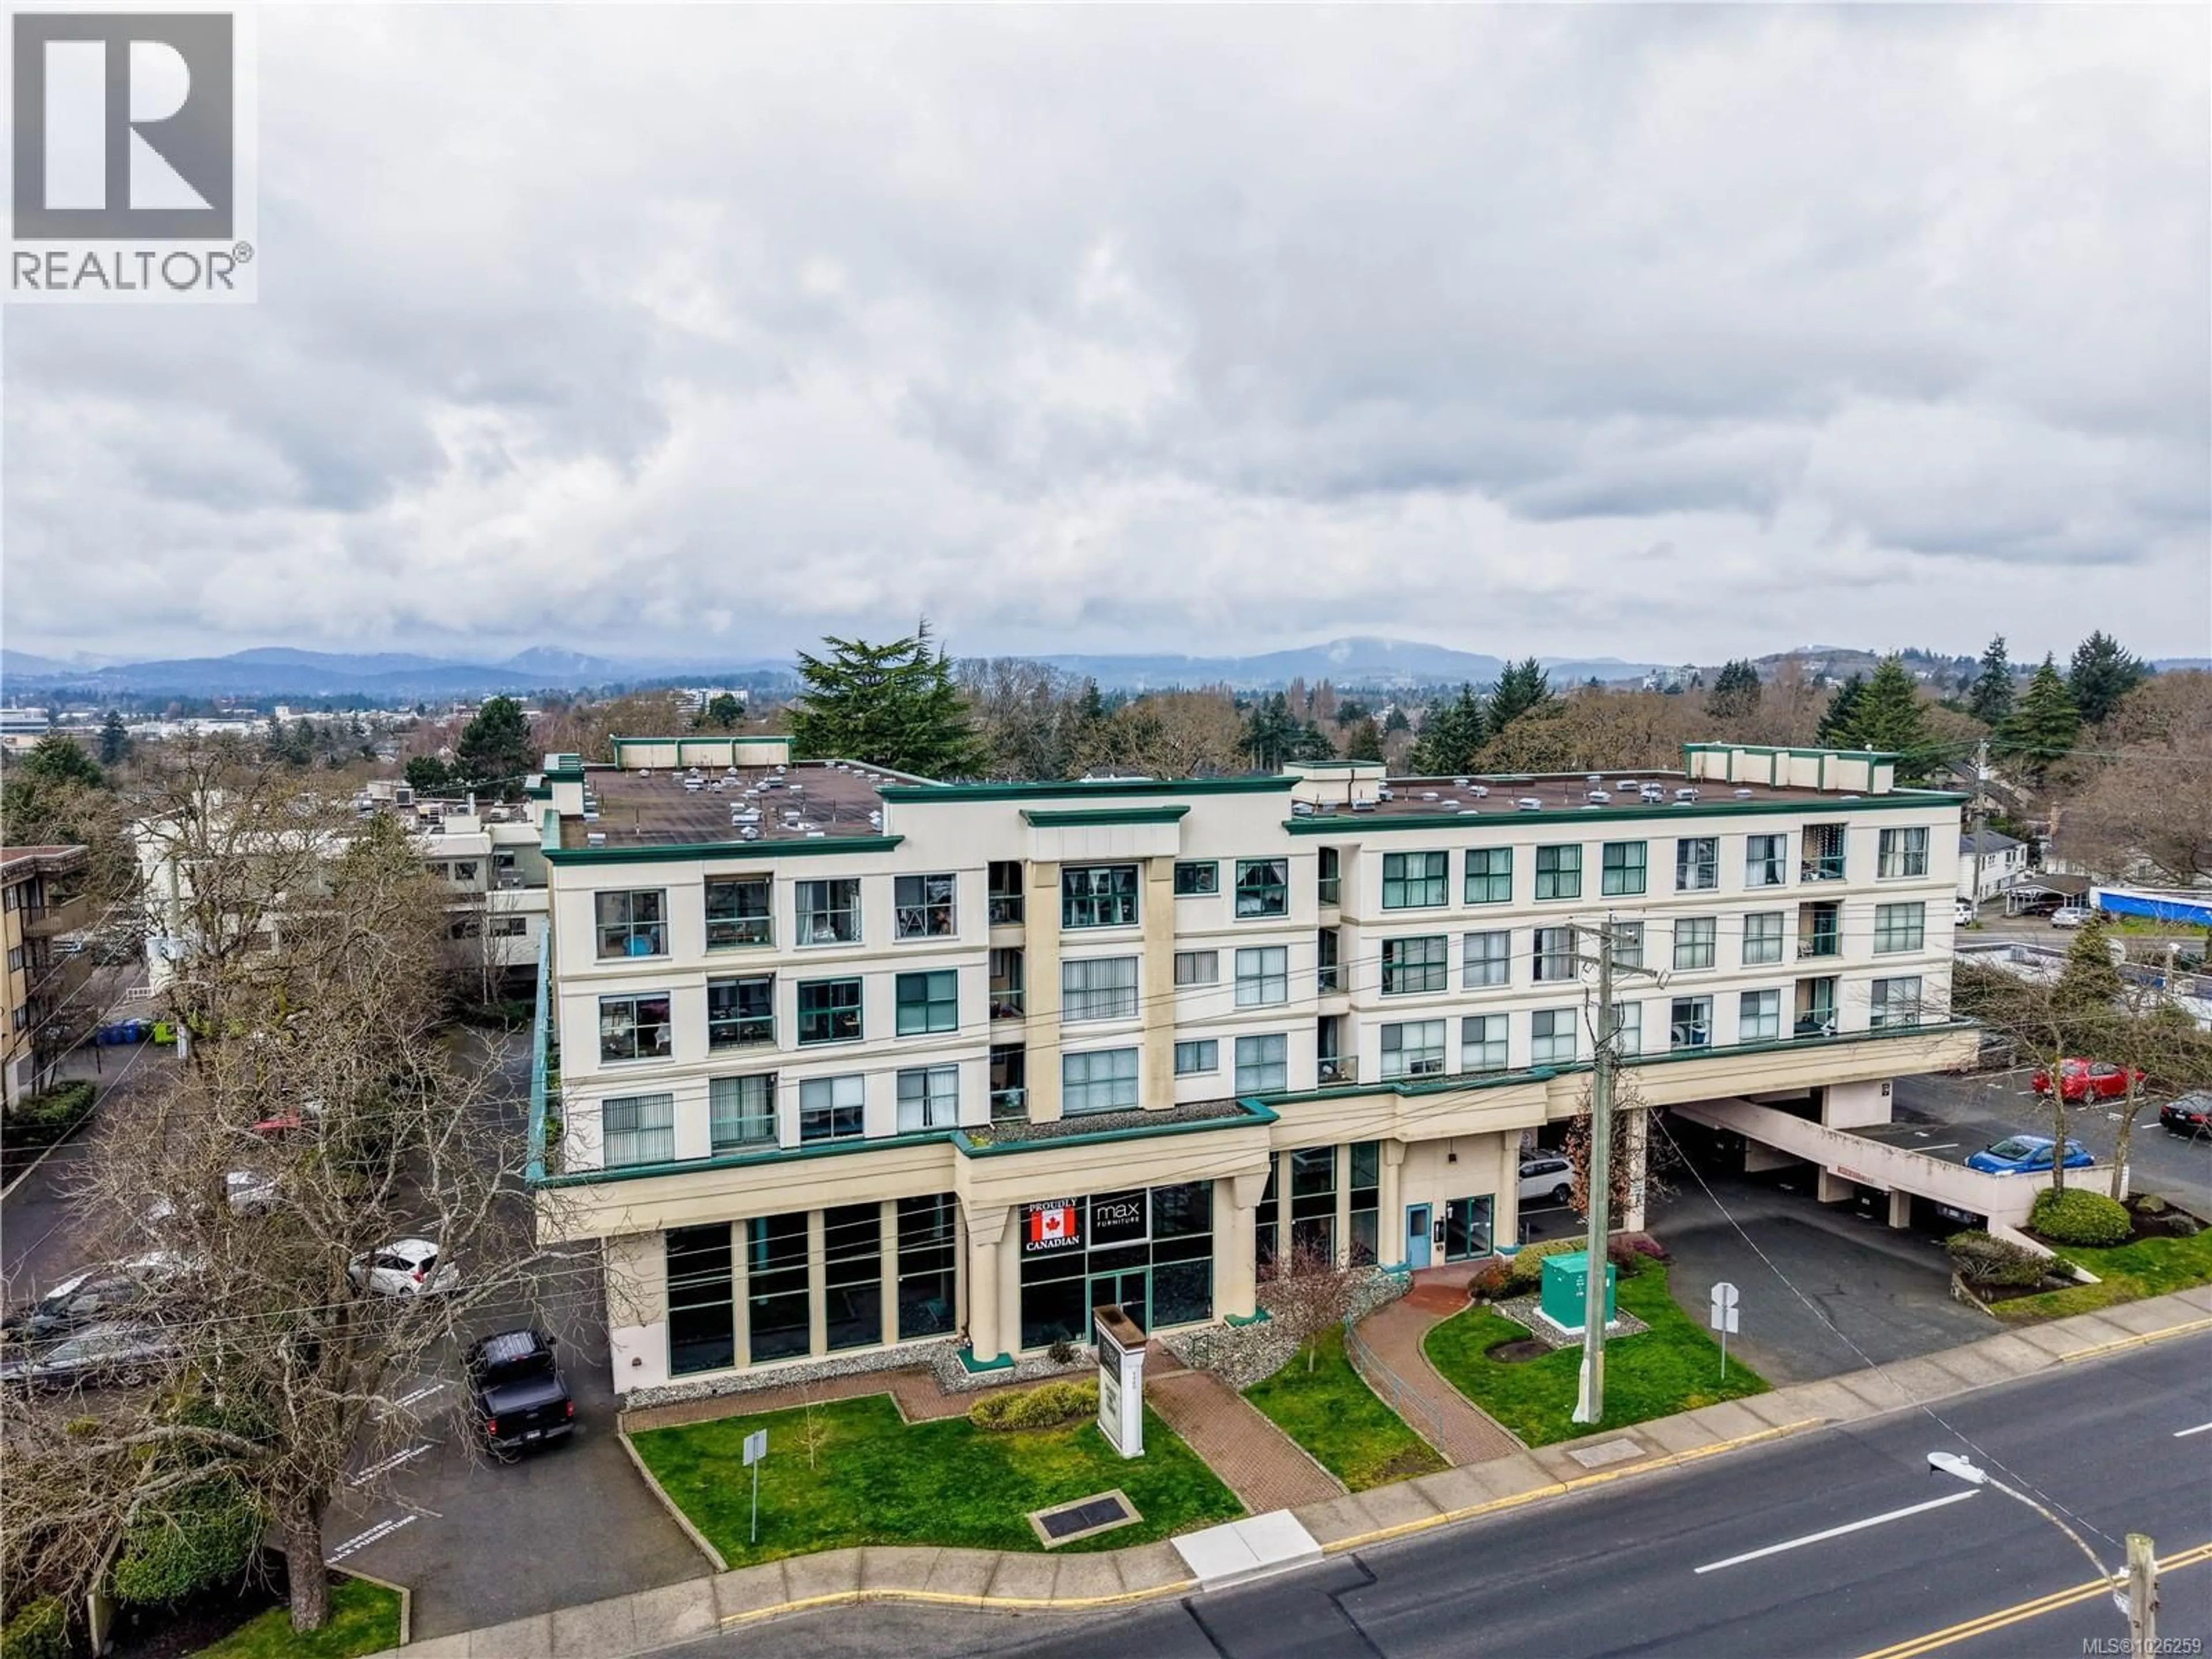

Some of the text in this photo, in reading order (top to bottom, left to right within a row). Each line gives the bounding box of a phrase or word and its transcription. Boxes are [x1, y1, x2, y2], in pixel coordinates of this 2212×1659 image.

[1029, 1198, 1077, 1212] PROUDLY
[1097, 1203, 1140, 1220] max
[1096, 1216, 1140, 1228] FURNITURE
[1026, 1235, 1080, 1251] CANADIAN
